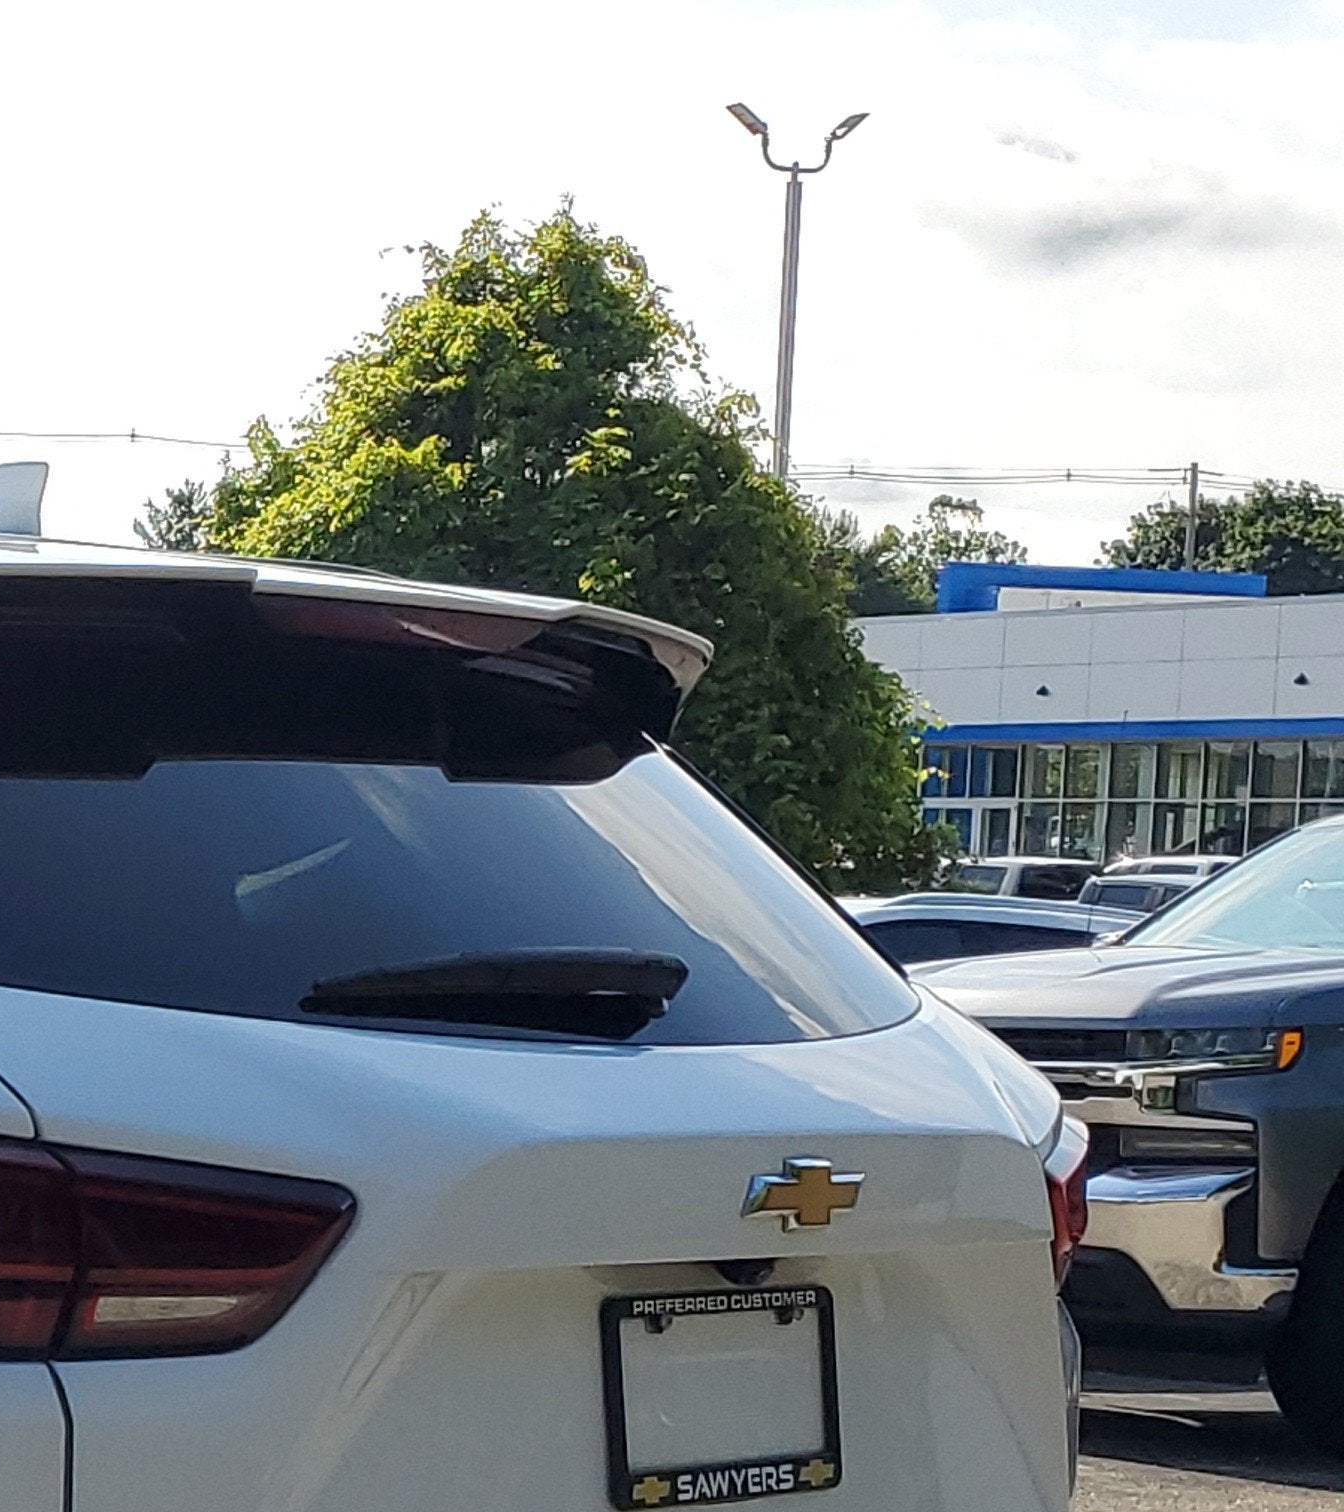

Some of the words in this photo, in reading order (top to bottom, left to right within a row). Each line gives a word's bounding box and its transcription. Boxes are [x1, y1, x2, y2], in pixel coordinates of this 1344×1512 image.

[632, 1295, 728, 1316] PREFERRED
[730, 1290, 816, 1311] CUSTOMER
[676, 1463, 794, 1501] SAWYERS
